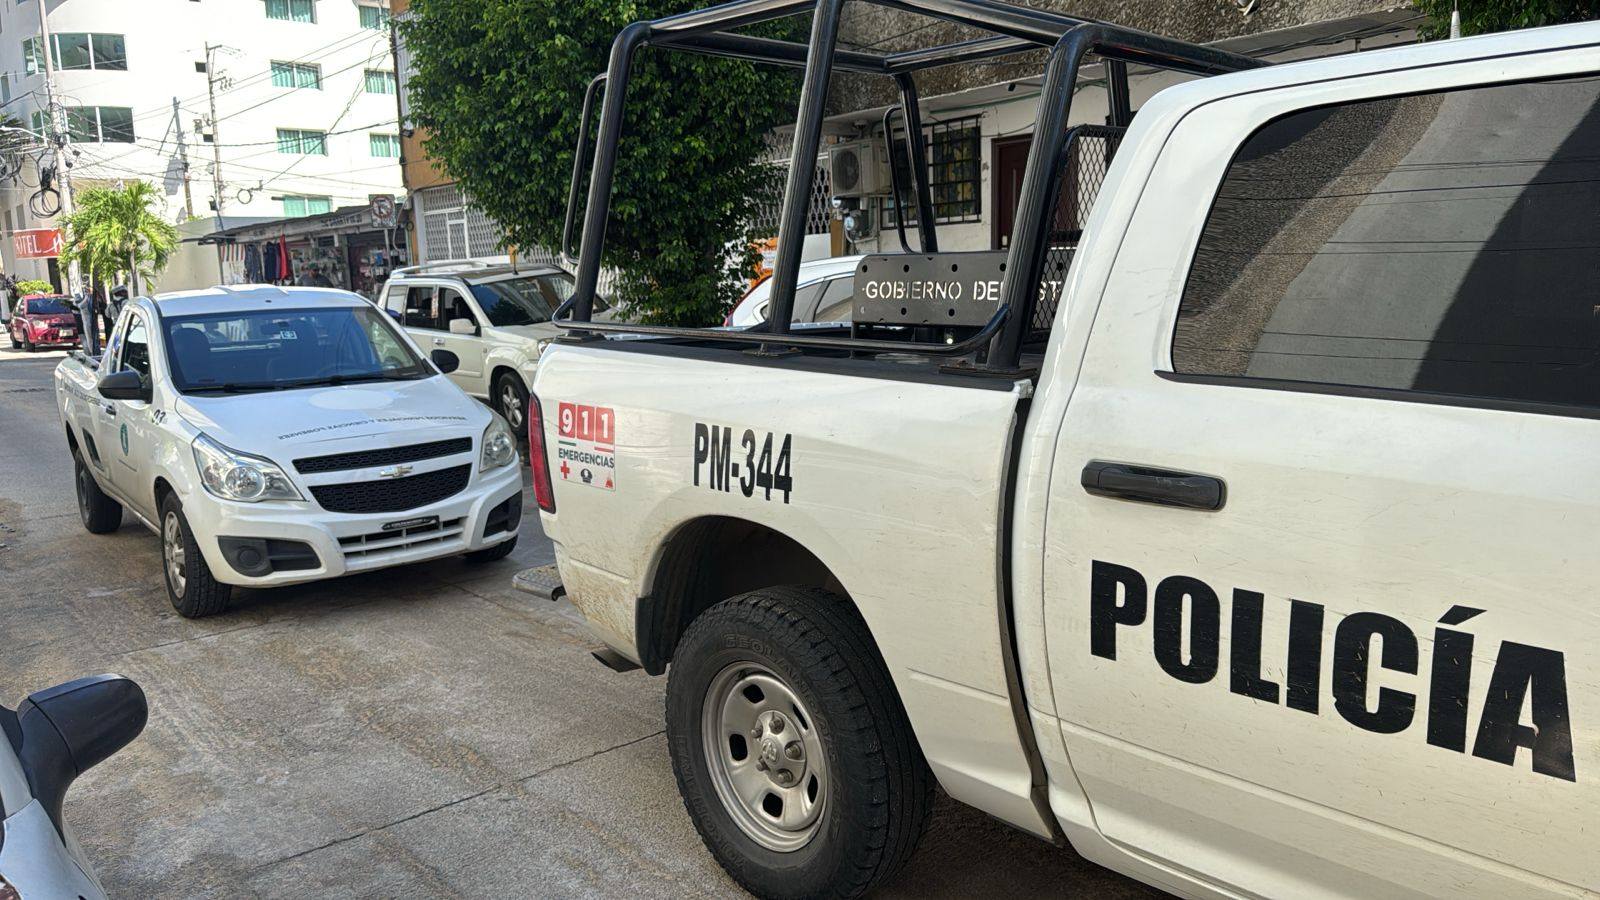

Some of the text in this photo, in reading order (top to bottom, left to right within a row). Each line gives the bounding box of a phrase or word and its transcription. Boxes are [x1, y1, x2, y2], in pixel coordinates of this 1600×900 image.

[864, 280, 1004, 301] GOBIERNO DE
[562, 408, 609, 439] 911
[558, 447, 615, 469] EMERGENCIAS
[693, 422, 793, 504] PM-344
[1090, 559, 1577, 783] POLICÍA
